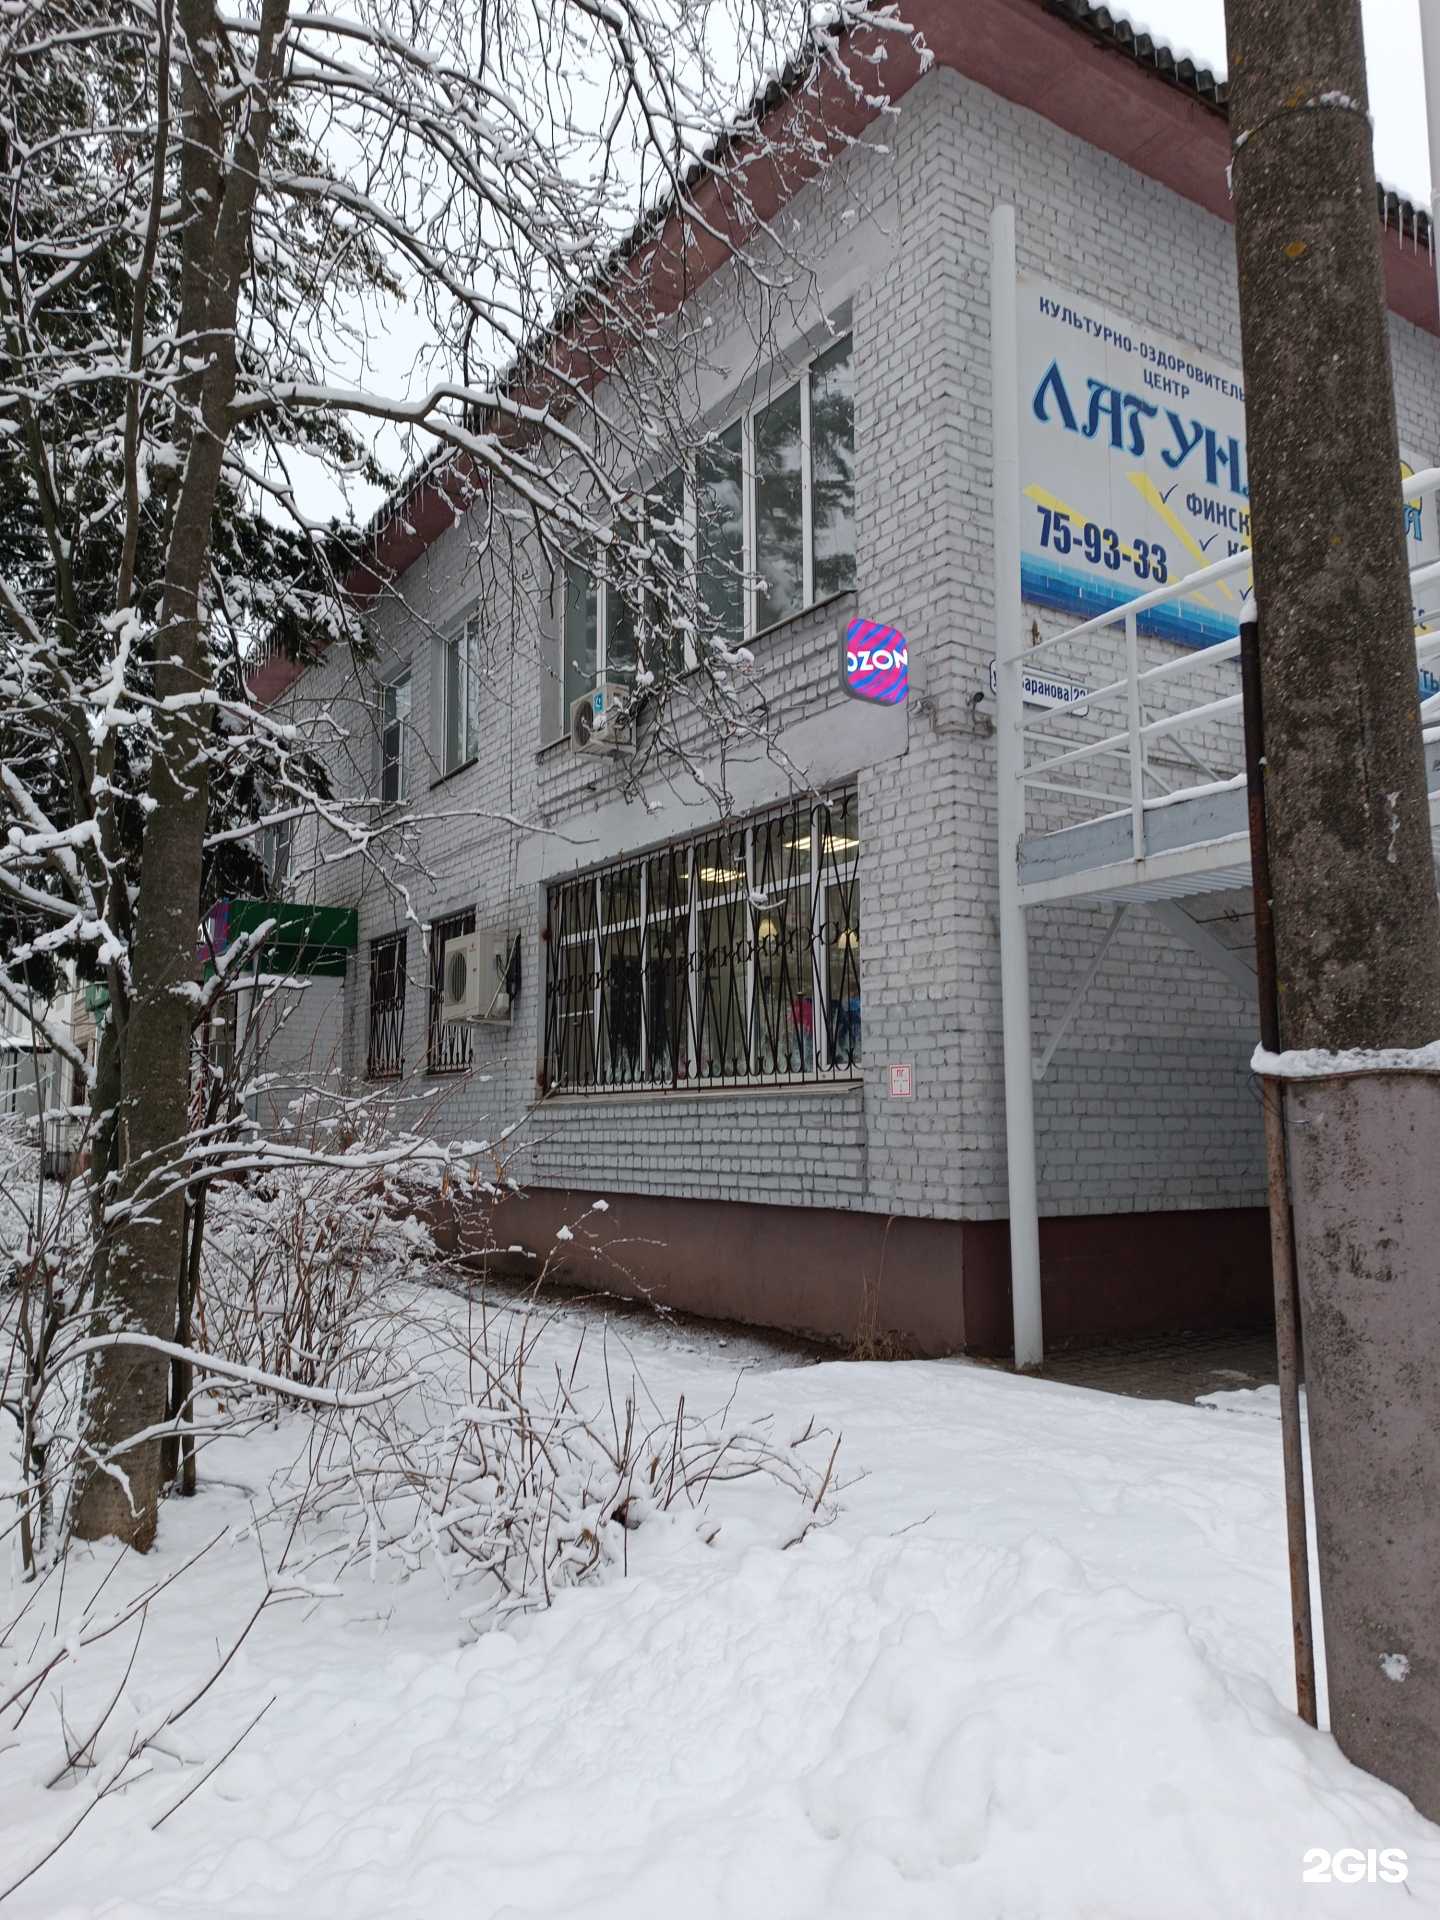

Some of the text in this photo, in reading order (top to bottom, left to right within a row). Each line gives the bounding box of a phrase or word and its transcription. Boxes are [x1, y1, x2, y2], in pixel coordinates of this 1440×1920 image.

[1039, 295, 1246, 402] КУЛЬТУРНО-ОЗДОРОВИТЕЛЬ
[1143, 368, 1190, 400] ЦЕНТР
[1033, 360, 1249, 497] ЛАГУН
[1186, 492, 1250, 537] ФИНСК
[1037, 504, 1168, 584] 75-93-33
[847, 649, 908, 672] OZON
[1022, 677, 1069, 702] аранова
